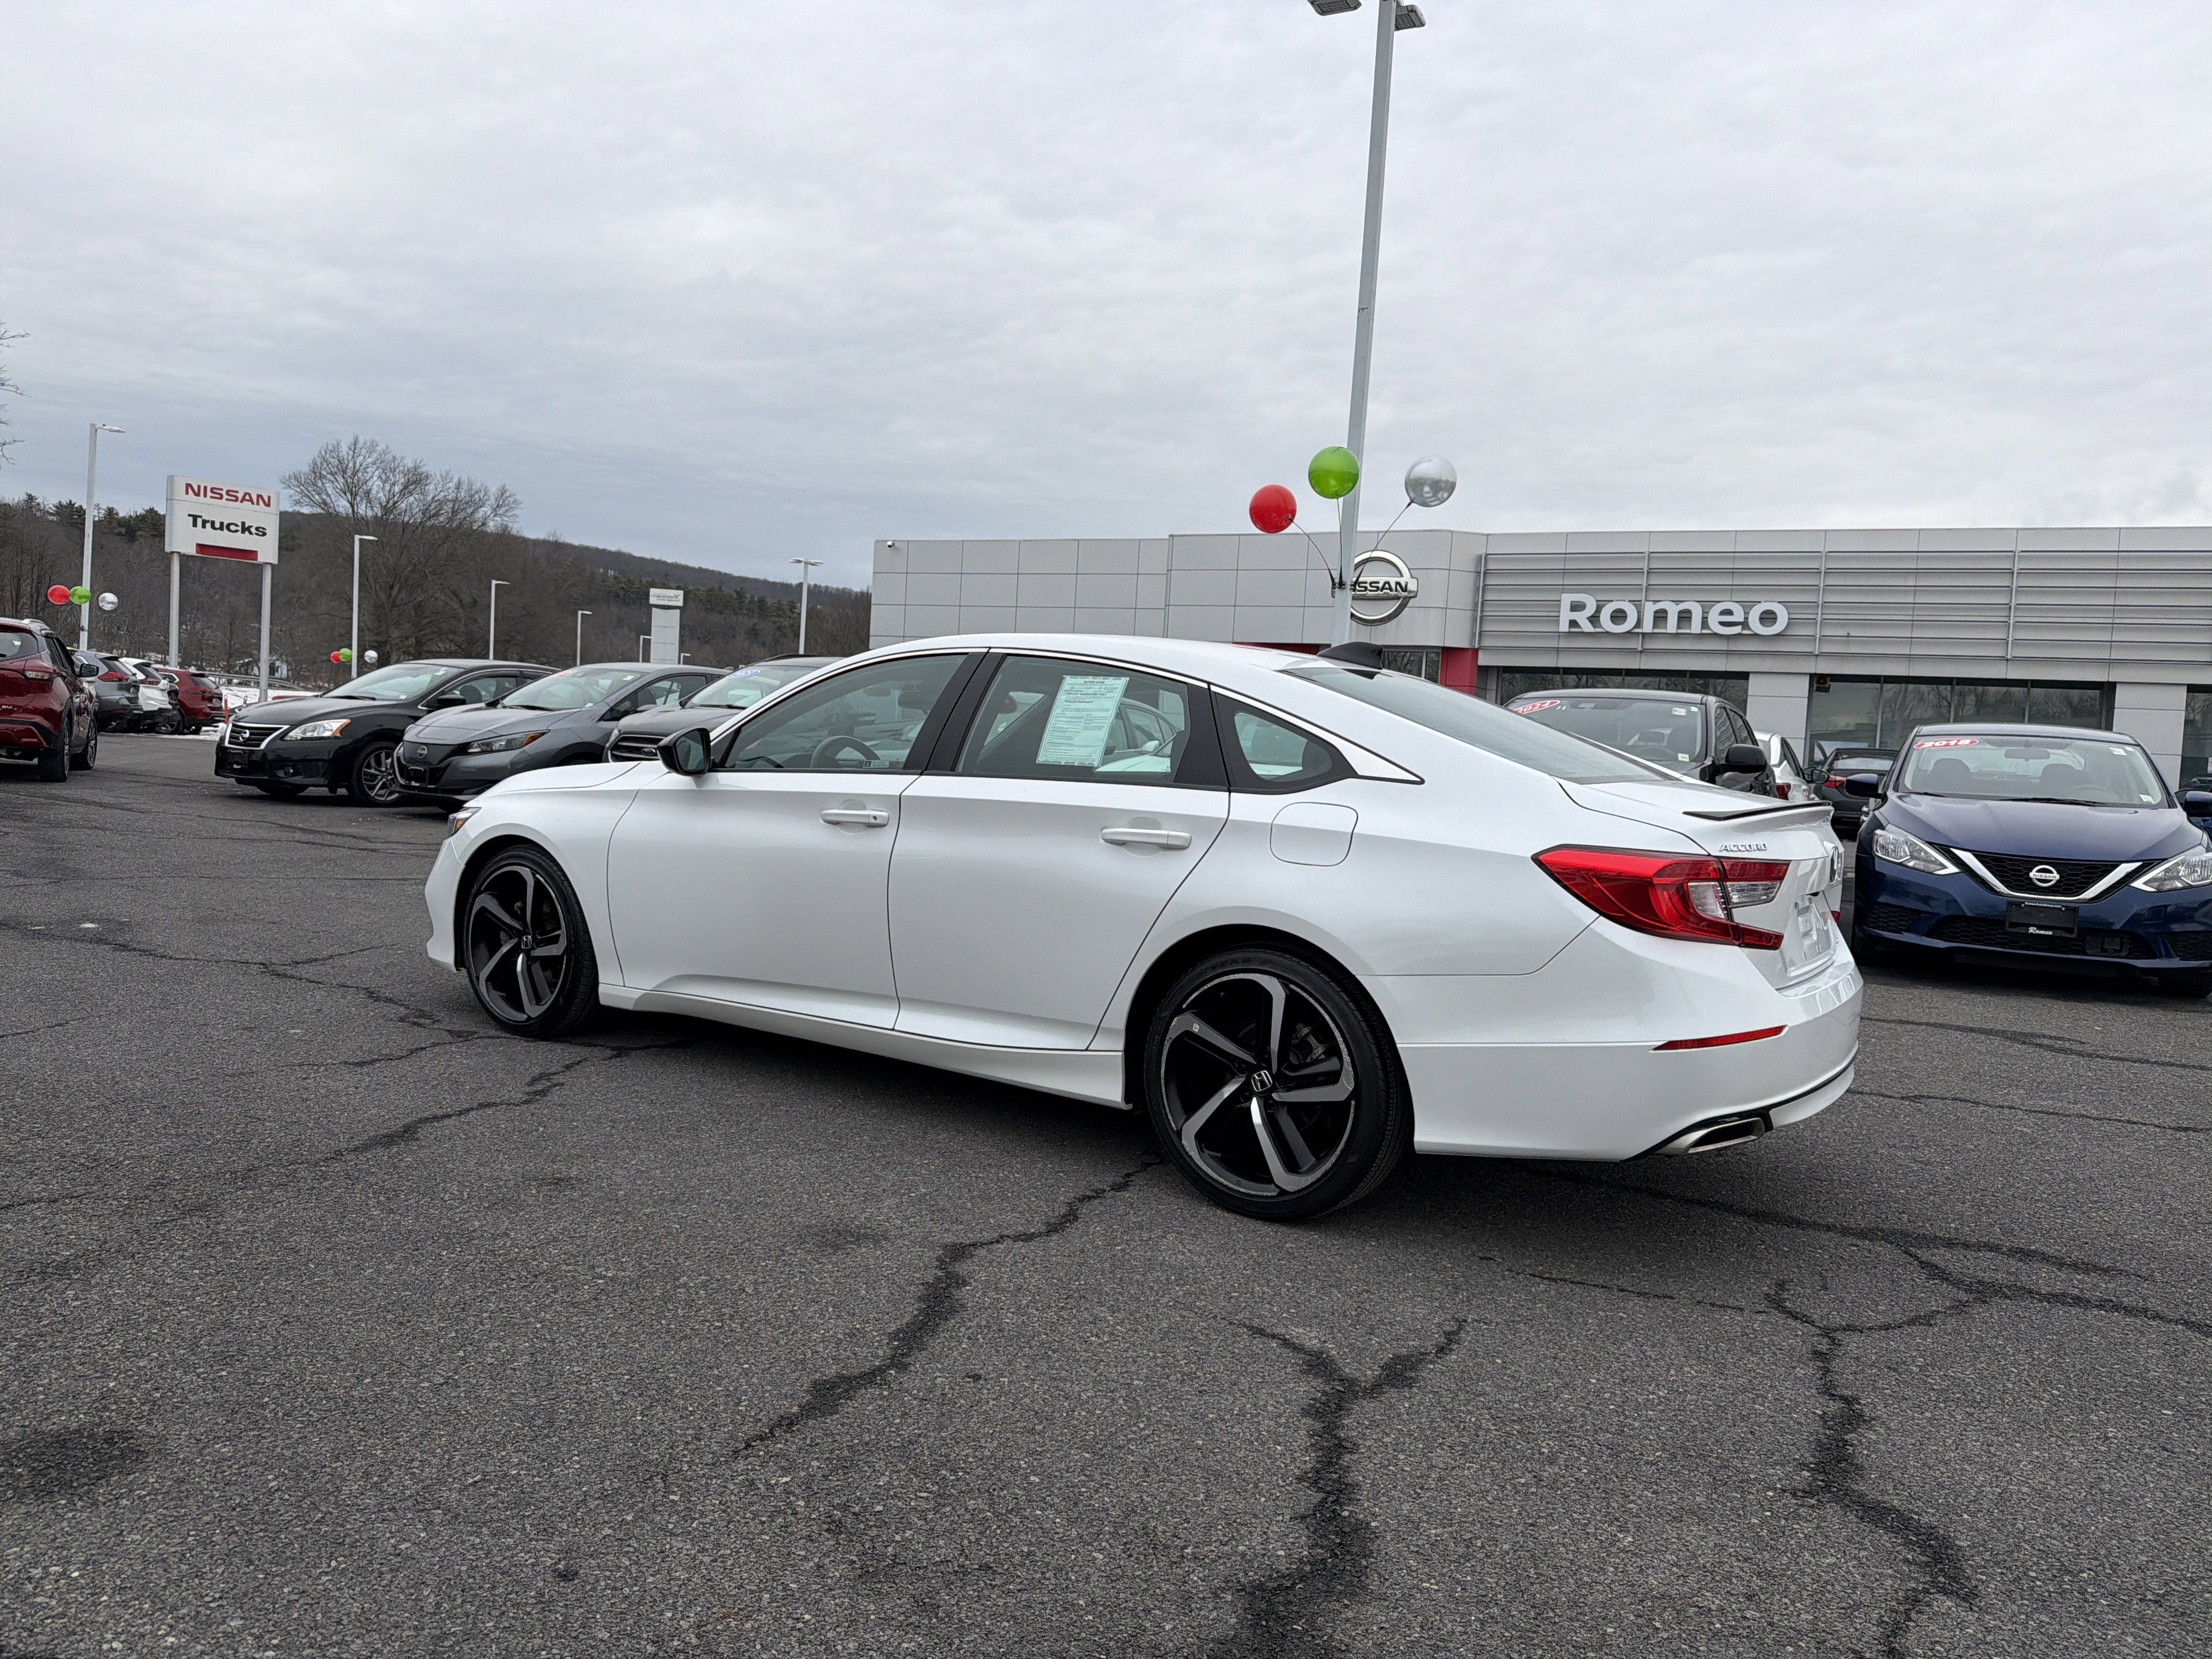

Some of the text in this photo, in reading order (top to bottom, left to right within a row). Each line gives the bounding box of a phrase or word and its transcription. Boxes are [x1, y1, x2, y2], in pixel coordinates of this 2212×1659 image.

[185, 482, 272, 508] NISSAN
[187, 513, 268, 537] Trucks
[1558, 592, 1790, 635] Romeo
[1921, 739, 1971, 748] 2018
[1718, 843, 1768, 853] ACCORD
[2028, 927, 2053, 935] Romeo
